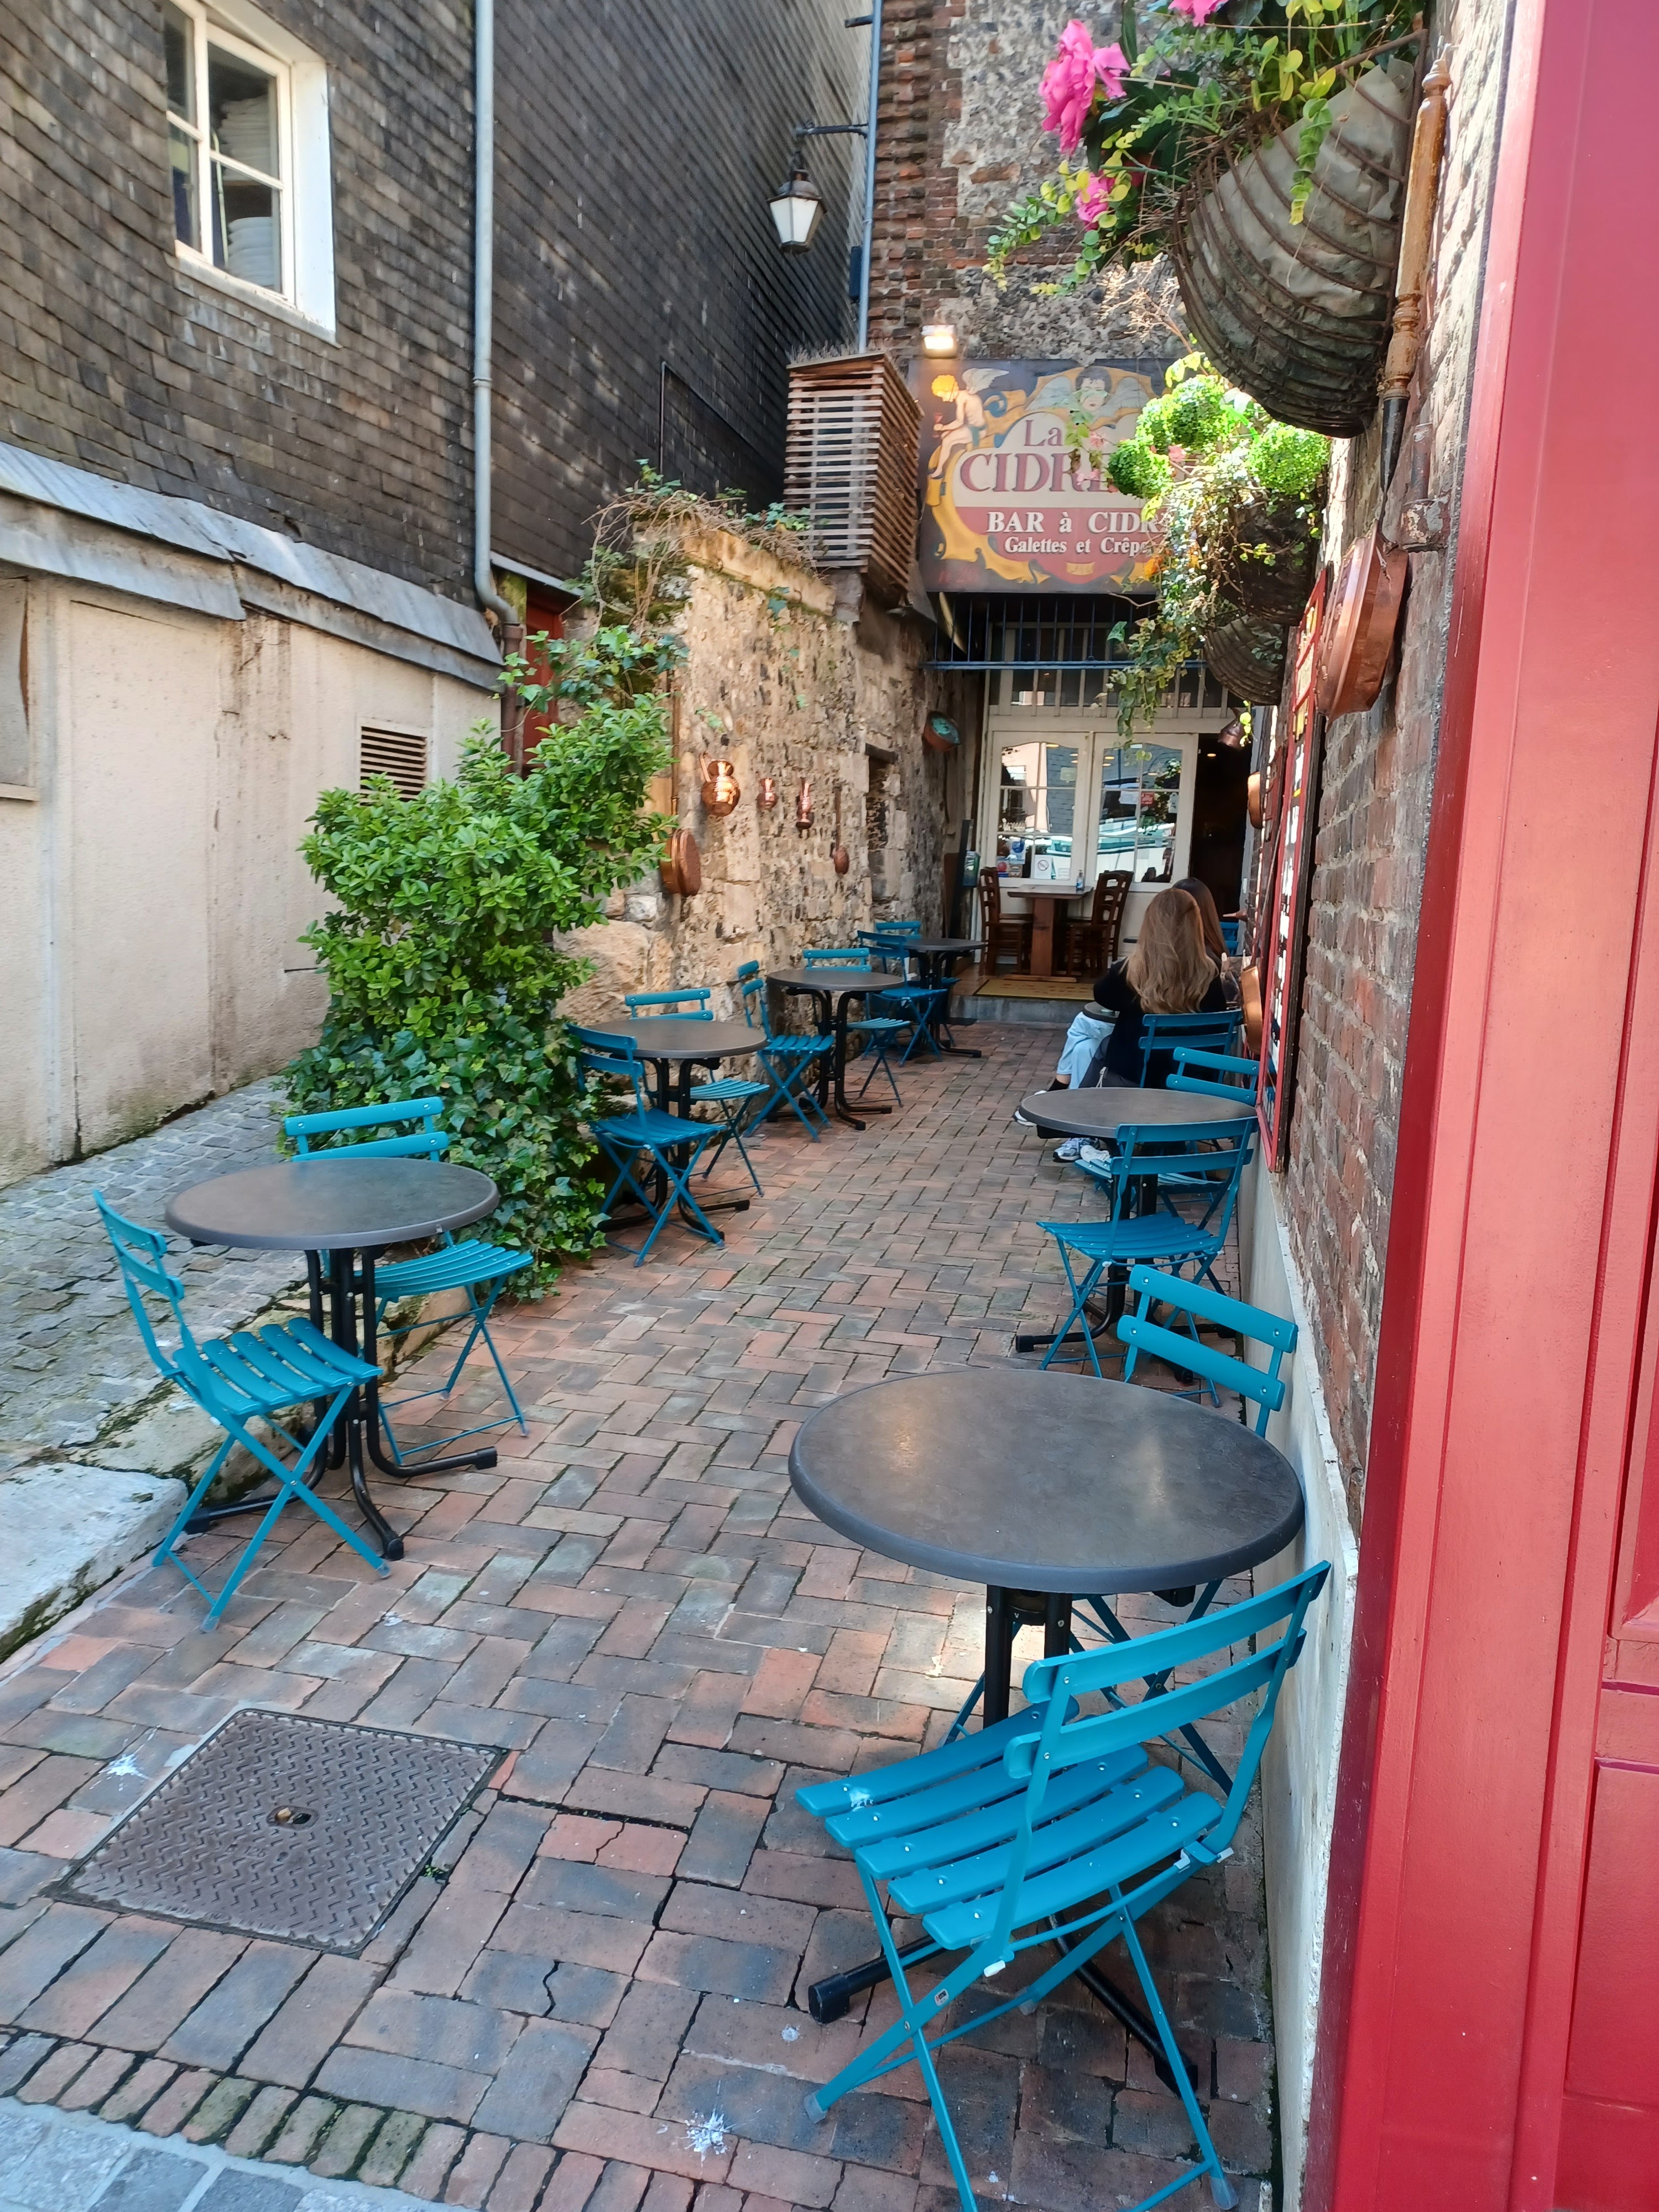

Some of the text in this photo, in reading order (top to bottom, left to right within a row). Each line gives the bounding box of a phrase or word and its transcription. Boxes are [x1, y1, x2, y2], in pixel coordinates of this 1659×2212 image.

[1023, 419, 1063, 447] La
[987, 511, 1166, 534] BAR à CIDR
[1004, 535, 1067, 554] Galettes
[1076, 538, 1091, 554] et
